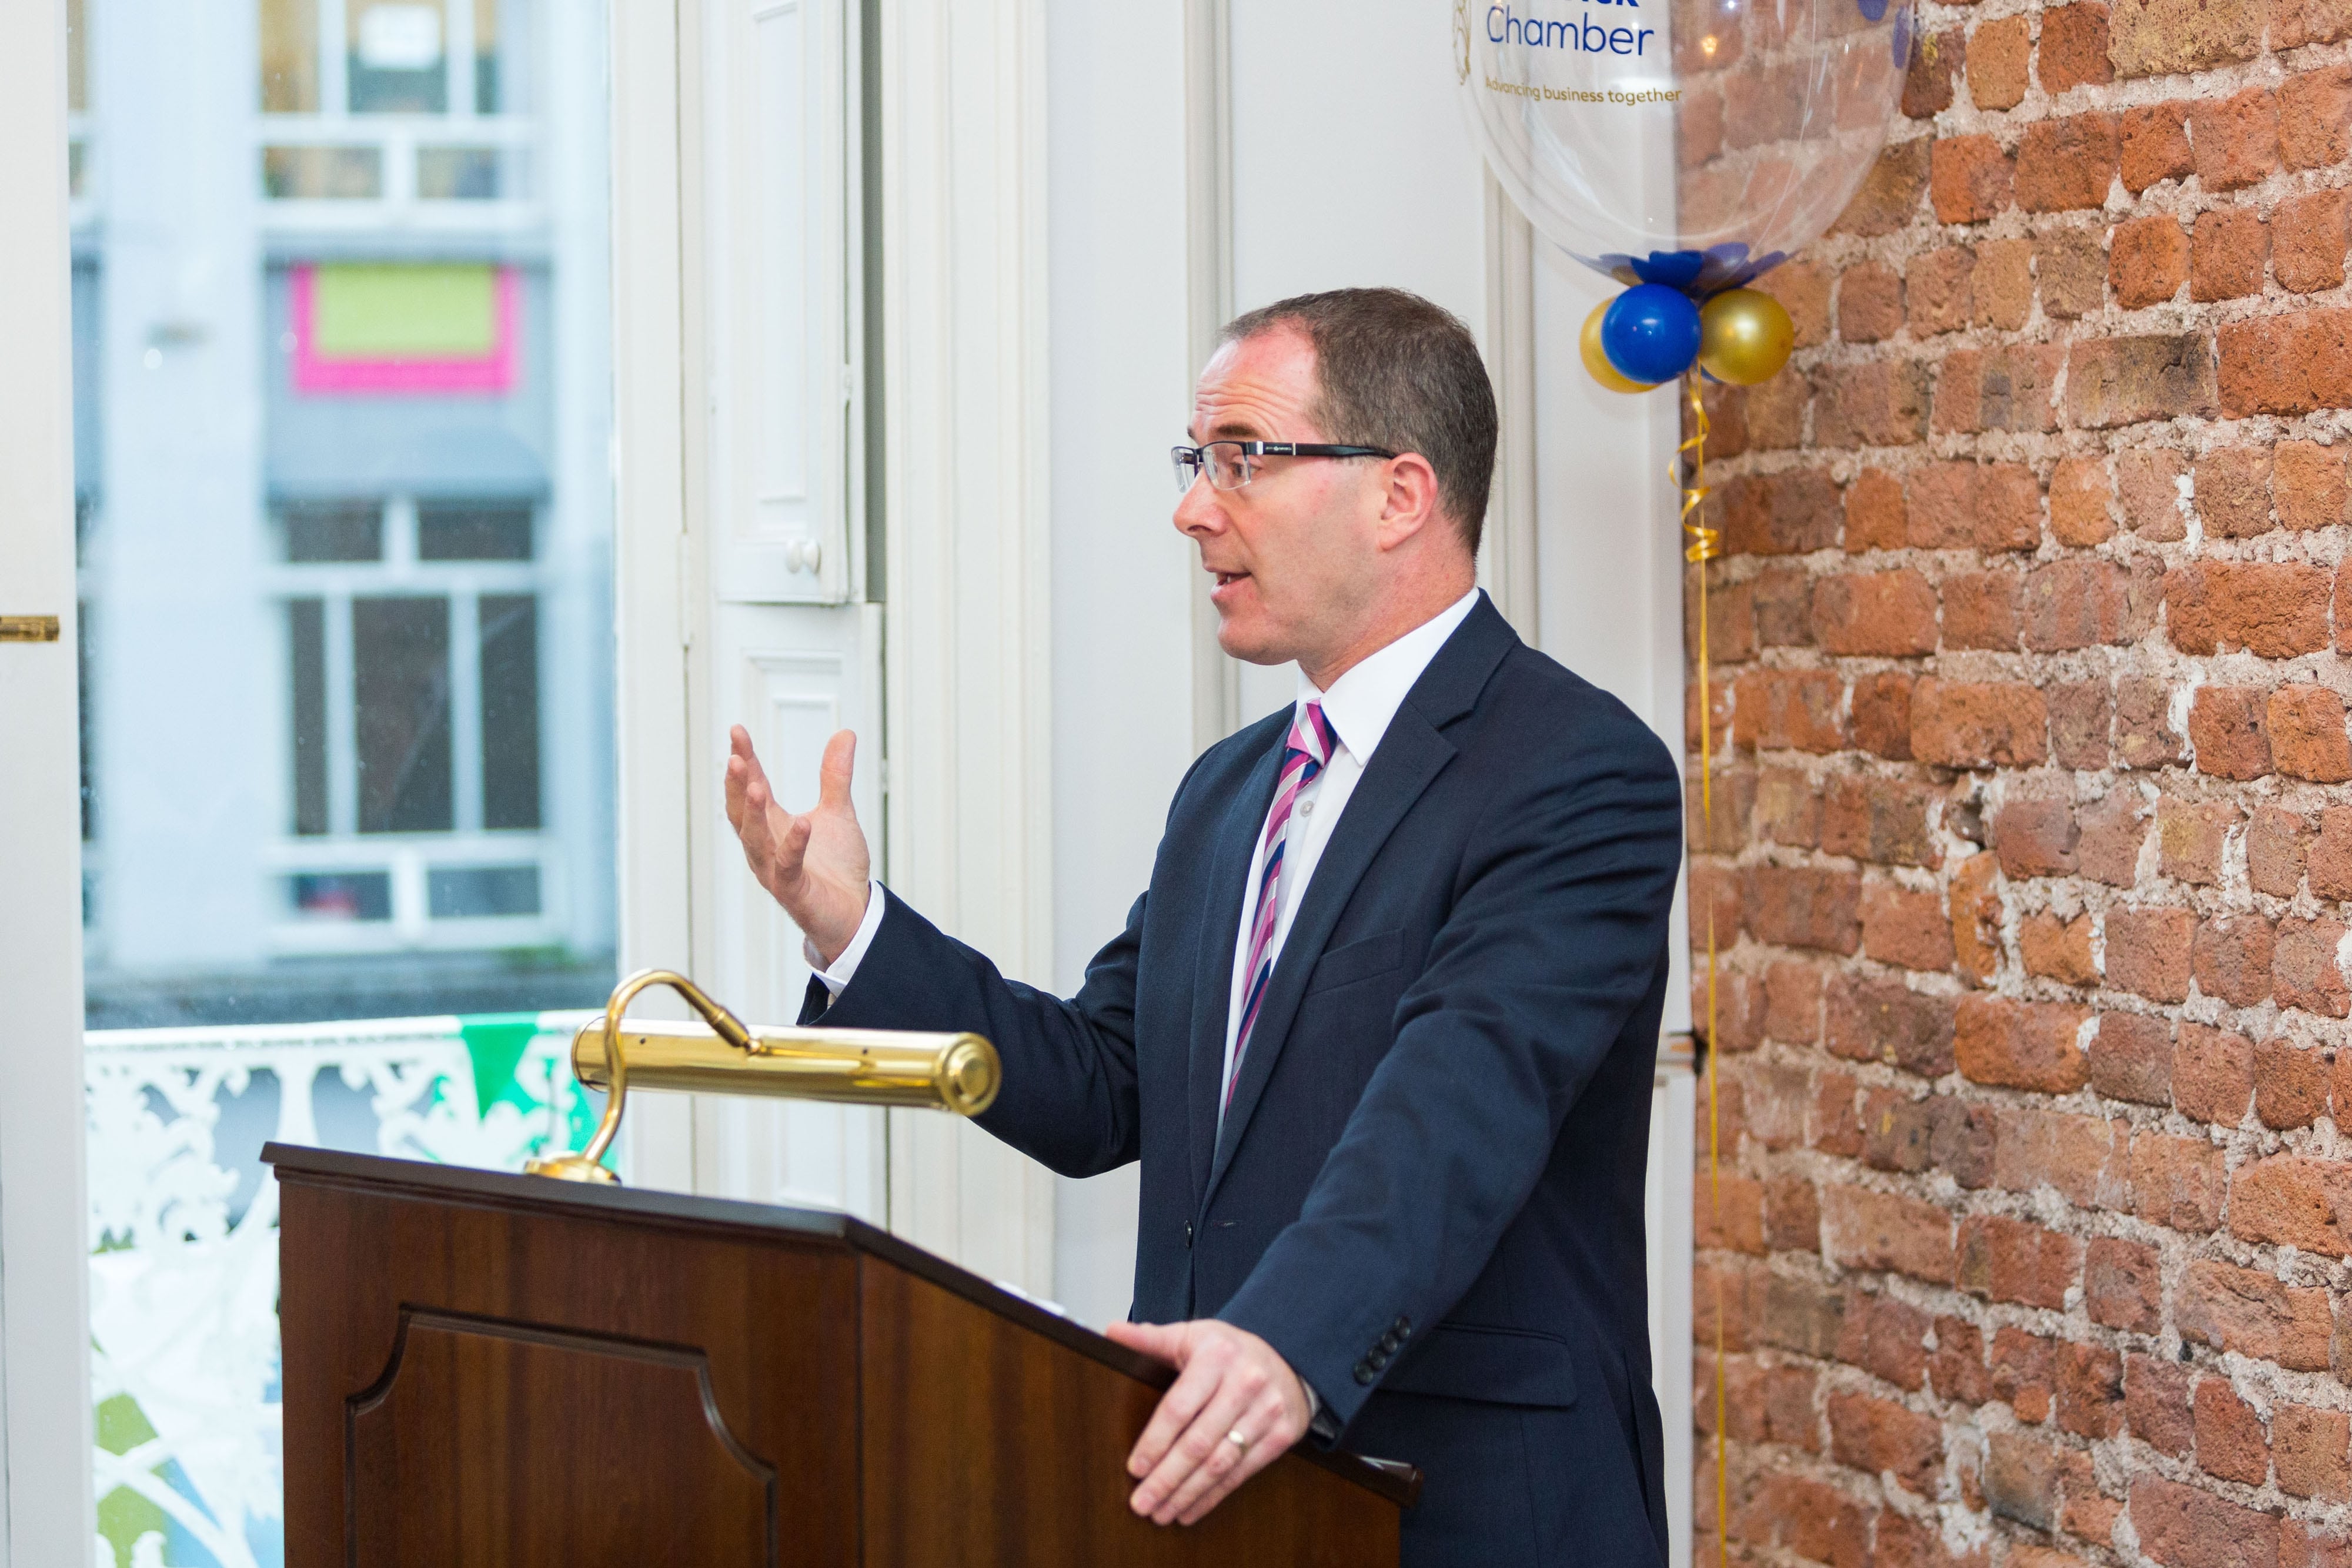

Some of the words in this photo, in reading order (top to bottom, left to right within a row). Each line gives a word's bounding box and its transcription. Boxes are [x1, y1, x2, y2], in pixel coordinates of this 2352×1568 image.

[1487, 5, 1655, 56] Chamber
[1485, 75, 1541, 101] Advancing
[1543, 84, 1605, 102] business
[1608, 87, 1683, 106] together
